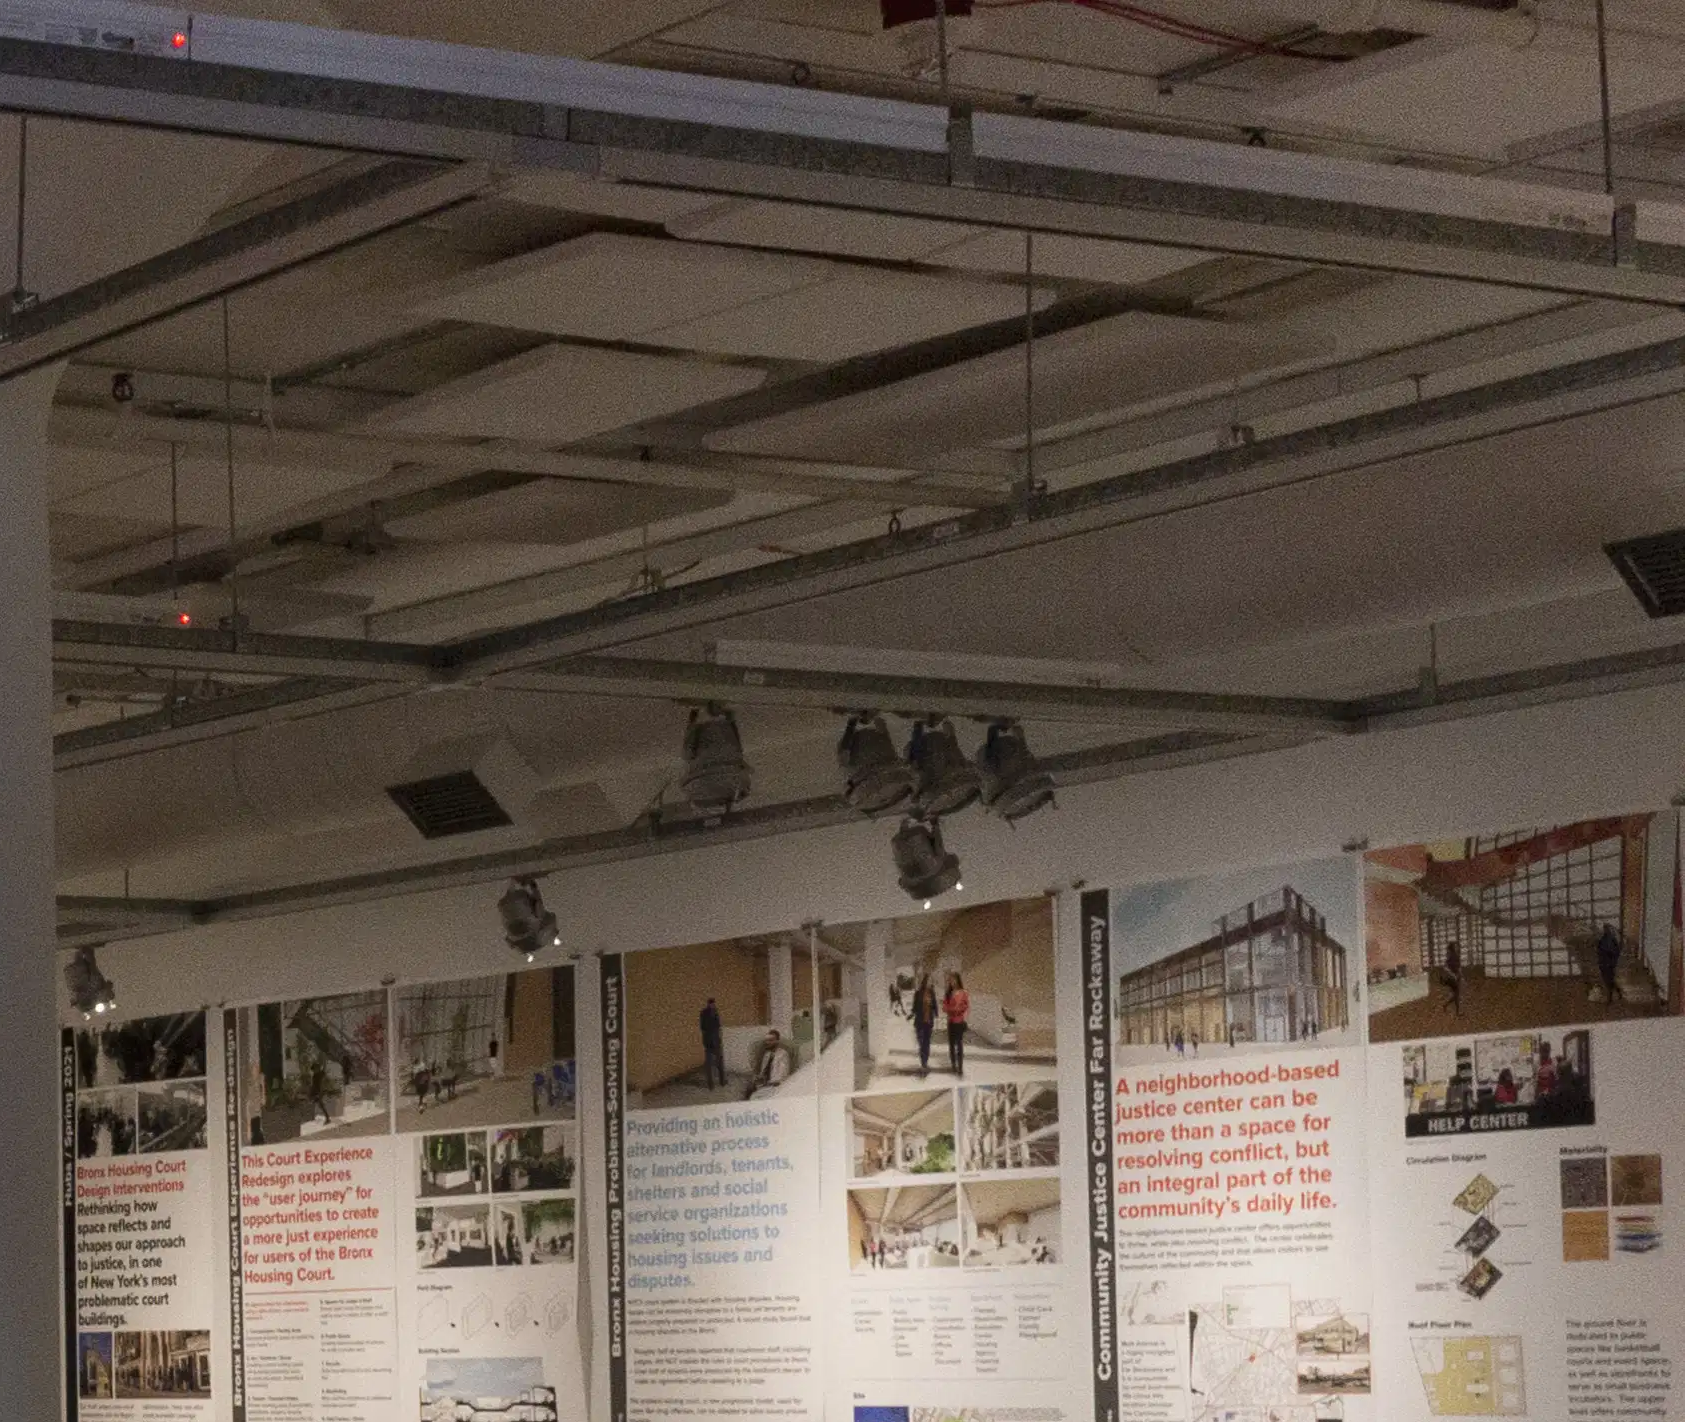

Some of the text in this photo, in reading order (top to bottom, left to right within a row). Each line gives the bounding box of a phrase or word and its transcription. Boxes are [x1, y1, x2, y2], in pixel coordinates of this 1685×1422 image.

[606, 975, 617, 1032] Court
[1115, 1060, 1340, 1096] A neighborhood-based
[1114, 1088, 1316, 1125] justice center can be
[606, 1037, 619, 1202] Problem-Solving
[1115, 1114, 1331, 1145] more than a space for
[1427, 1112, 1527, 1131] HELP CENTER
[1088, 914, 1111, 1380] Community Justice Center Far Rockaway
[1116, 1140, 1329, 1170] resolving conflict, but
[75, 1159, 186, 1179] Bronx Housing Court
[1116, 1165, 1332, 1194] an integral part of the
[75, 1178, 183, 1199] Design Interventions
[76, 1199, 157, 1216] Rethinking how
[1246, 1192, 1293, 1214] daily
[1300, 1191, 1336, 1209] life.
[76, 1216, 171, 1237] space reflects and
[76, 1234, 185, 1255] shapes our approach
[608, 1208, 621, 1290] Housing
[77, 1255, 162, 1273] to justice, in one
[78, 1274, 90, 1289] of
[90, 1275, 115, 1289] New
[150, 1273, 177, 1286] most
[78, 1292, 169, 1310] problematic court
[78, 1311, 127, 1327] buildings.
